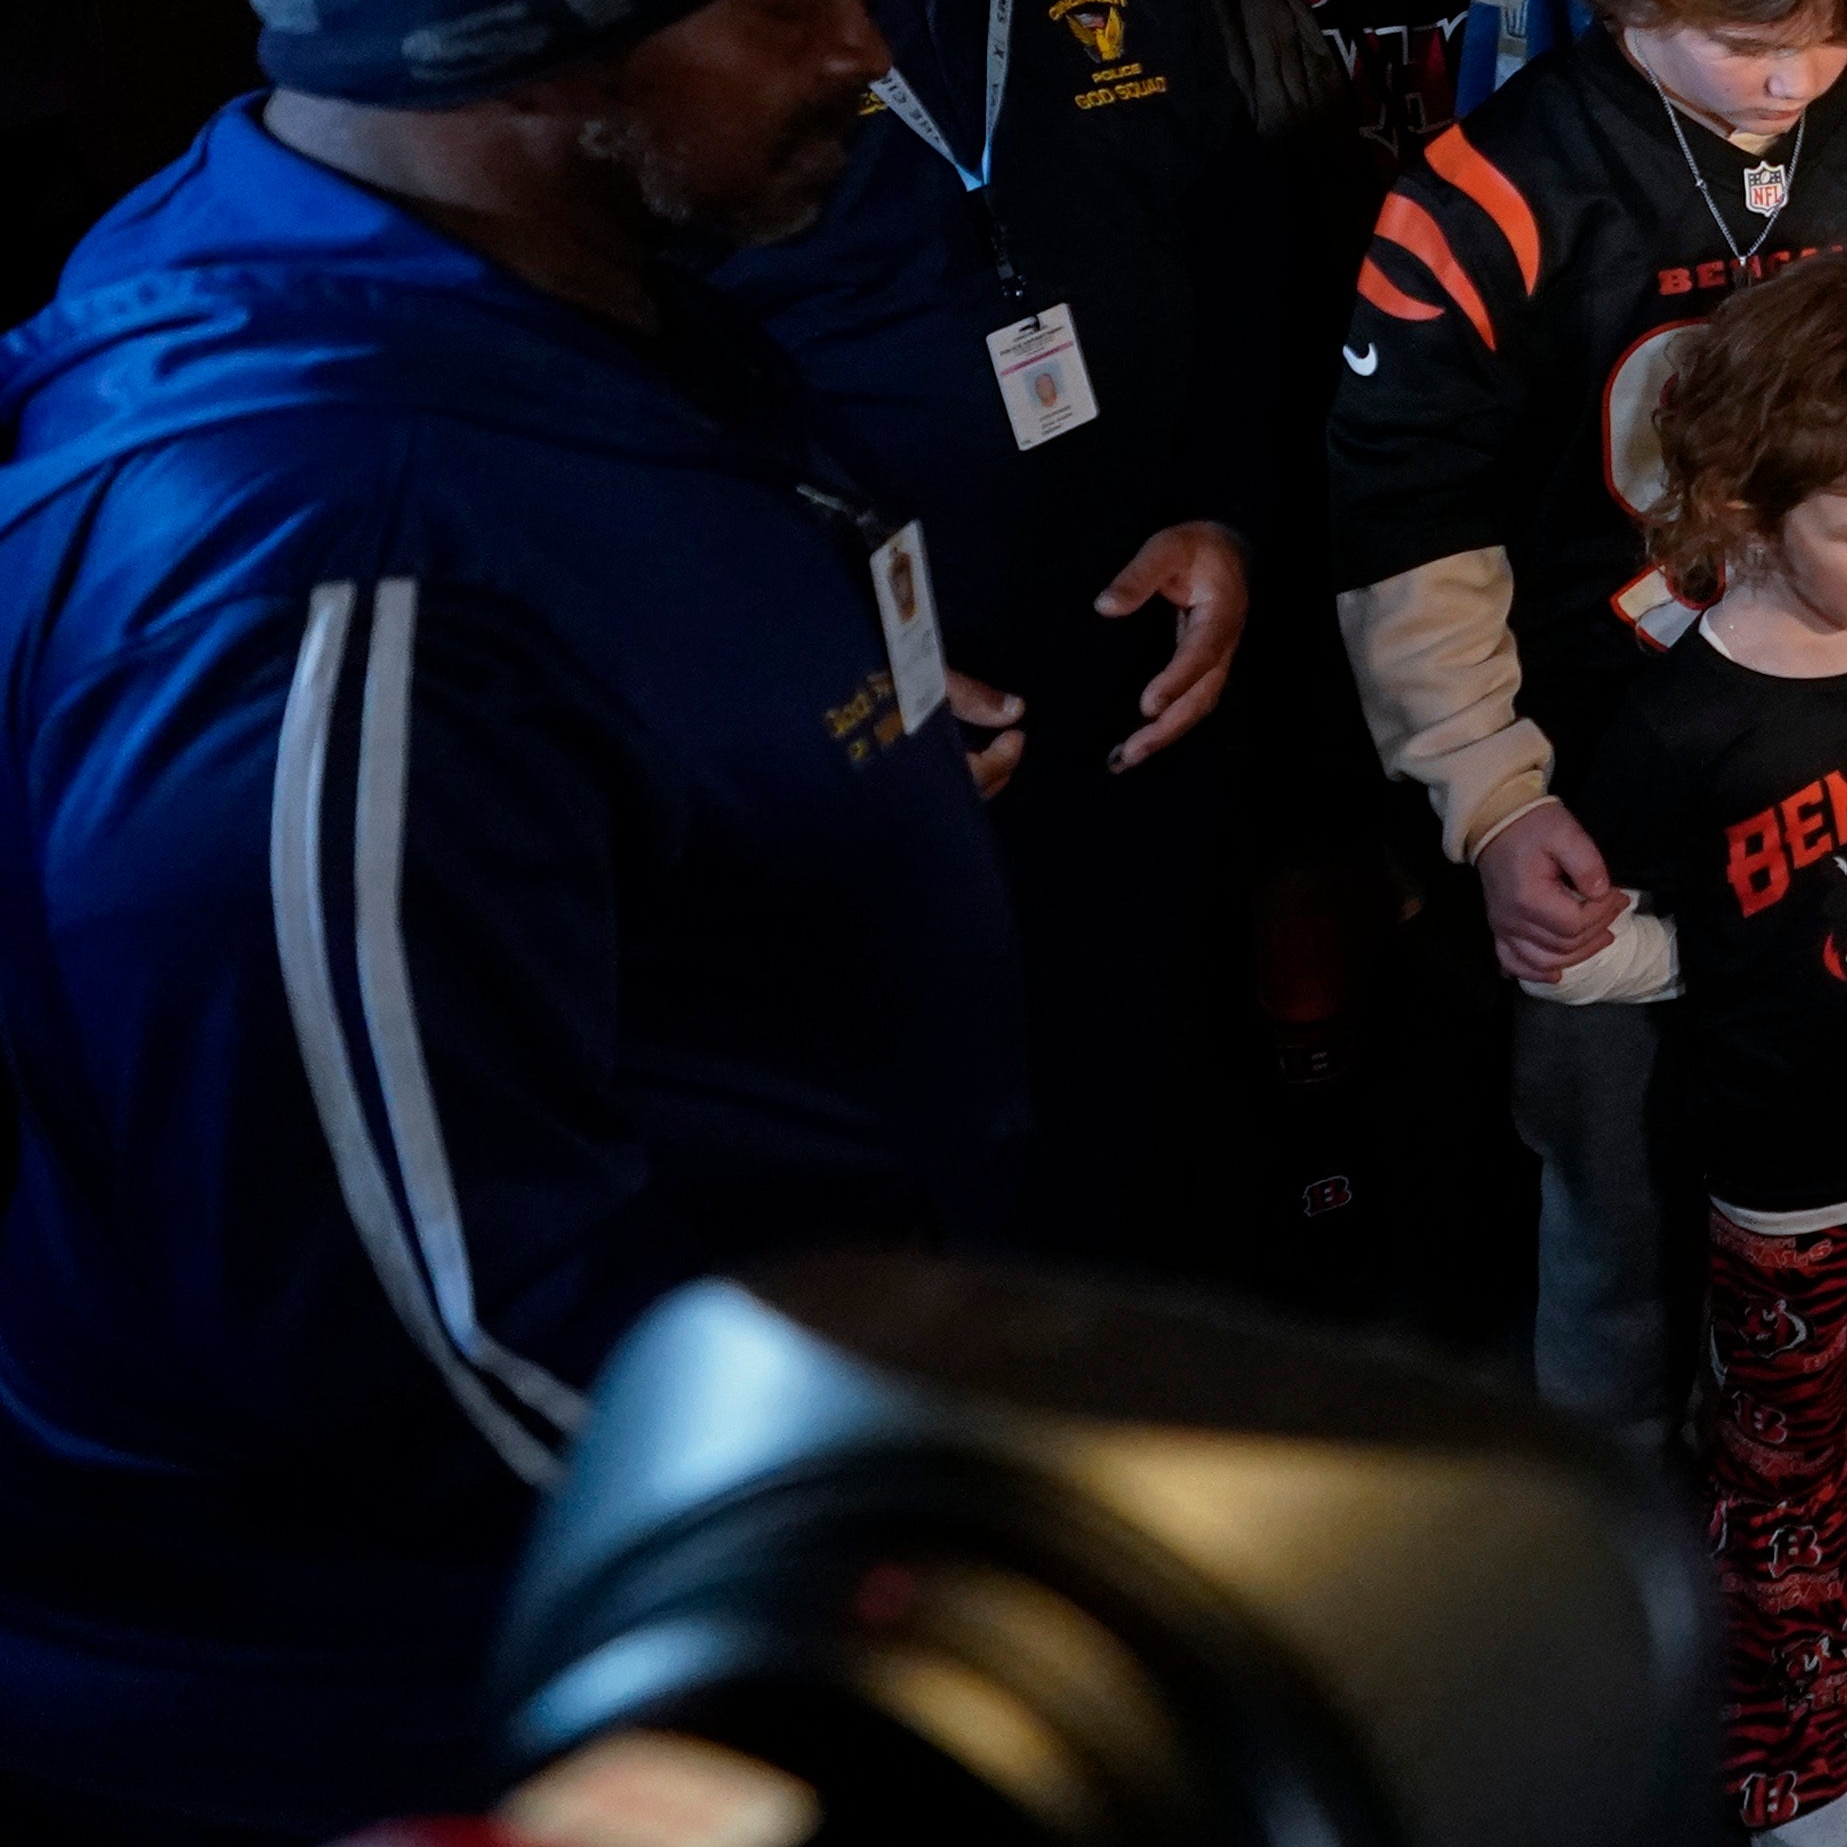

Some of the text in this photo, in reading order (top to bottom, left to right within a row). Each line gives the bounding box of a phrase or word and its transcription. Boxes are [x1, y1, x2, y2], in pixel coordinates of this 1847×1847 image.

[1074, 75, 1167, 110] GOD SQUAD
[1754, 185, 1785, 205] NFL
